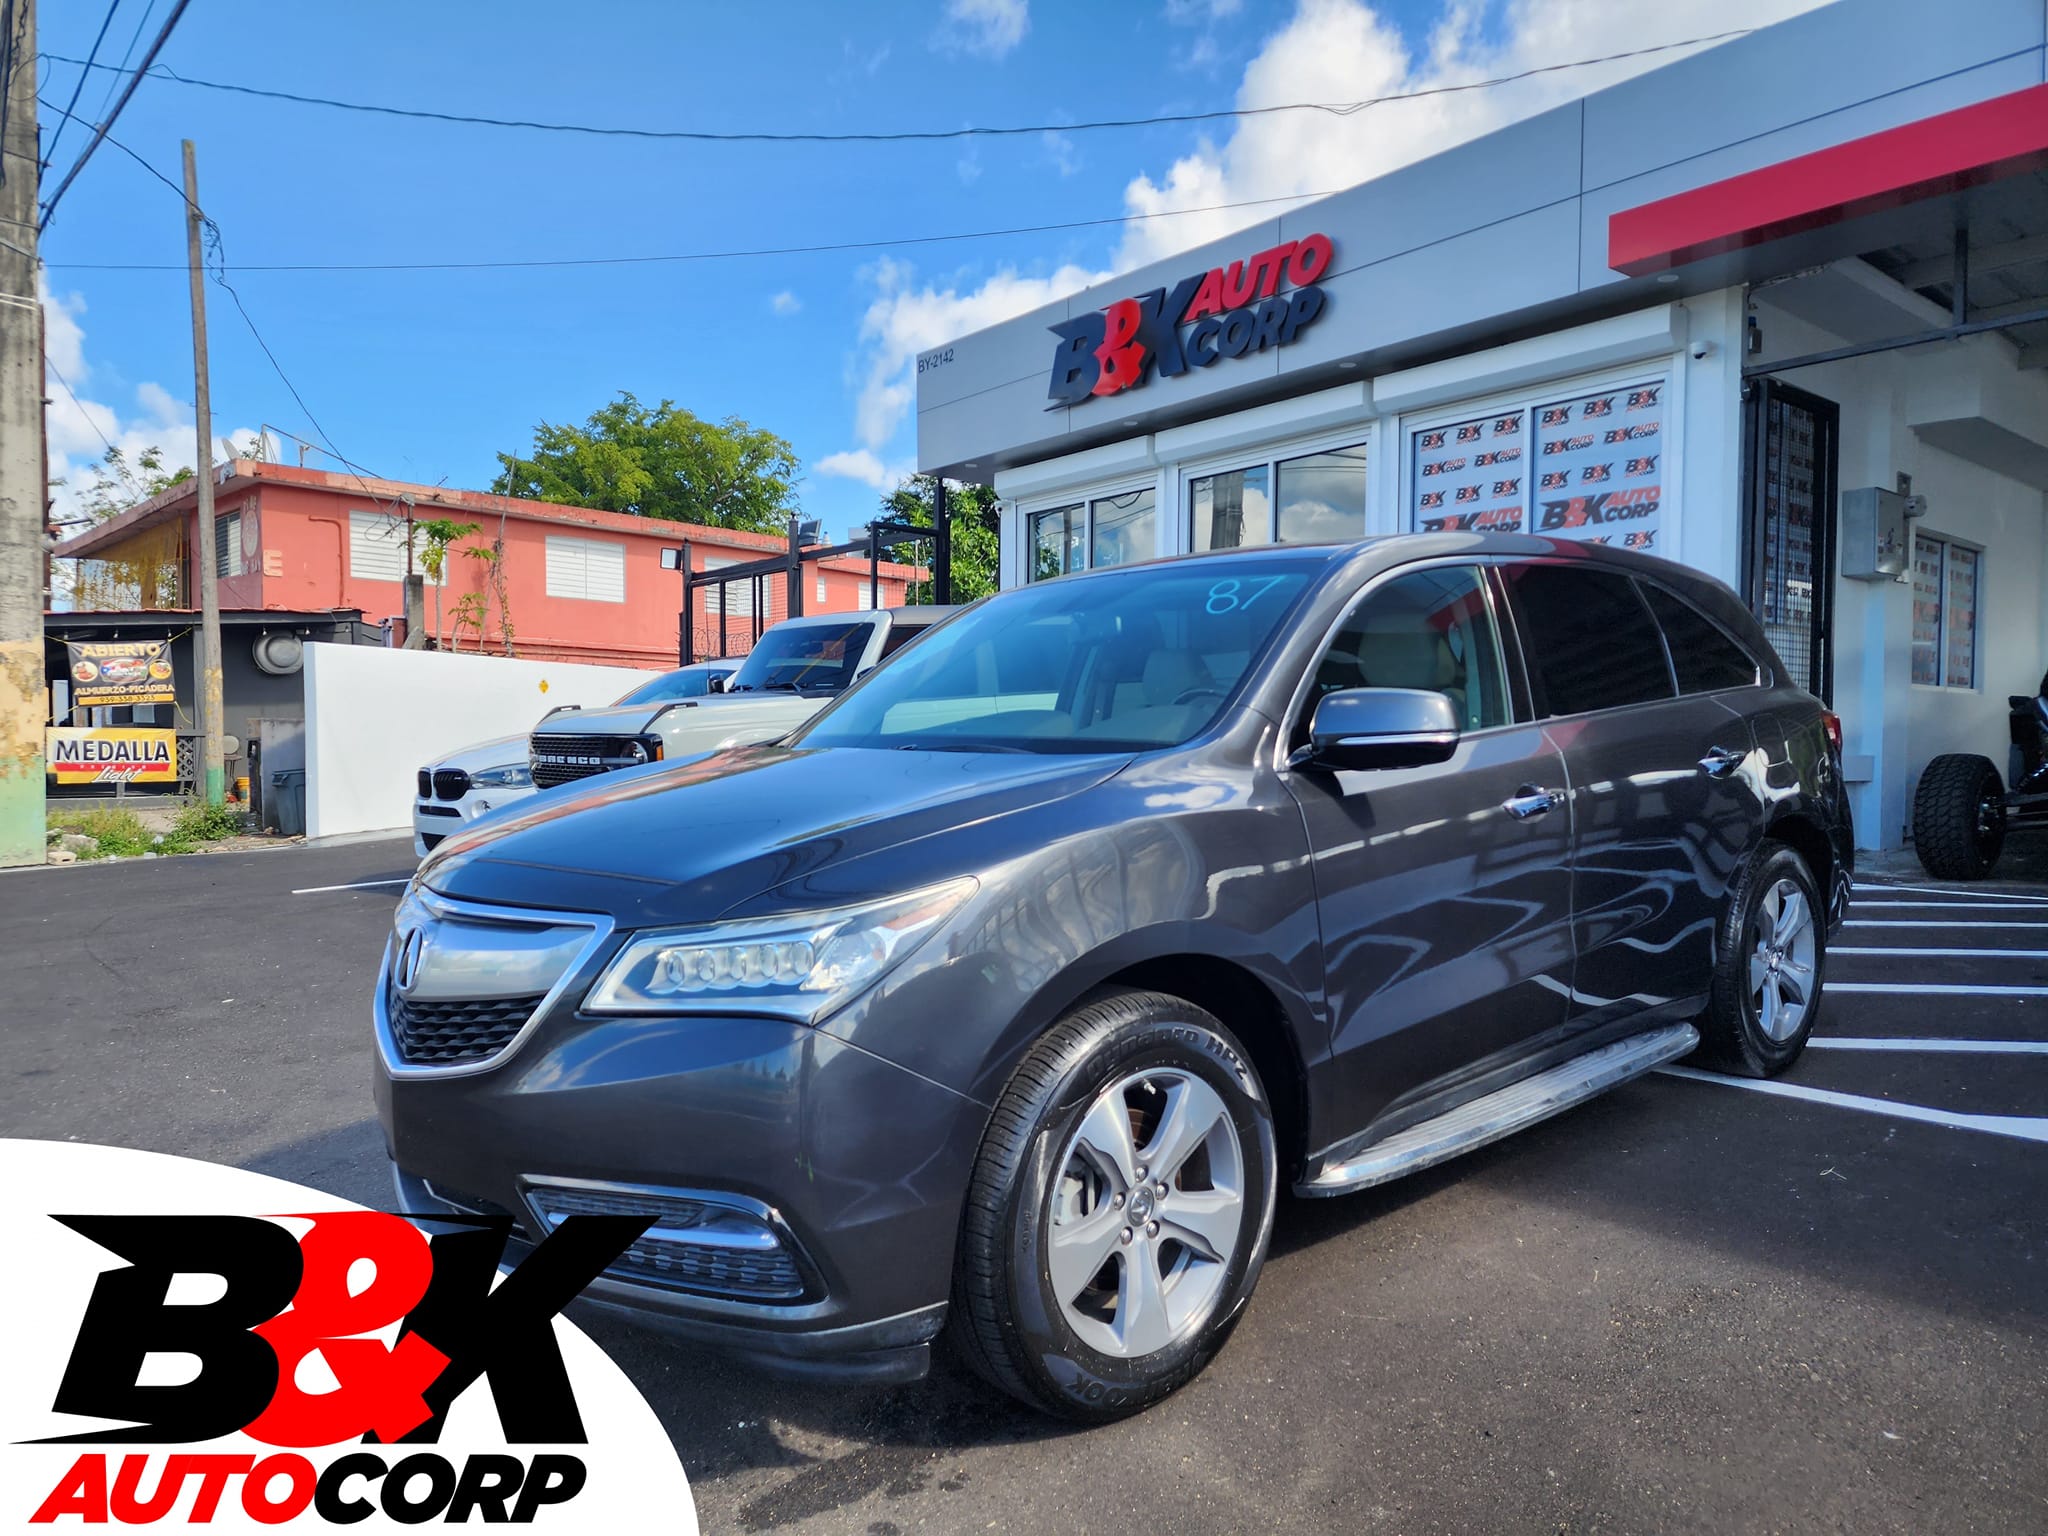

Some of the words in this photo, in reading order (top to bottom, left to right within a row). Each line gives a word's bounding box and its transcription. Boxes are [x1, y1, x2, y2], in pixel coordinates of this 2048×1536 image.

[1043, 273, 1208, 412] B&K
[1184, 233, 1334, 323] AUTO
[1186, 286, 1328, 367] CORP
[918, 348, 954, 374] BY-2142
[1627, 387, 1661, 406] B&K
[1542, 405, 1572, 423] B&K
[1583, 397, 1616, 415] B&K
[1456, 423, 1484, 440] B&K
[1493, 415, 1523, 432] B&K
[1421, 431, 1448, 447] B&K
[1603, 426, 1636, 444] B&K
[1633, 422, 1660, 432] AUTO
[1633, 429, 1658, 438] CORP
[1543, 438, 1573, 455] B&K
[1570, 433, 1594, 443] AUTO
[1571, 441, 1594, 450] CORP
[1474, 451, 1501, 467] B&K
[1500, 447, 1521, 457] AUTO
[1625, 455, 1659, 473] B&K
[1422, 461, 1447, 476] B&K
[1541, 469, 1571, 486] B&K
[1582, 463, 1614, 479] B&K
[1456, 484, 1483, 500] B&K
[1493, 478, 1521, 494] B&K
[1421, 490, 1446, 505] B&K
[1474, 506, 1523, 525] AUTO
[1536, 492, 1613, 532] B&K
[1604, 485, 1661, 508] AUTO
[1605, 501, 1659, 522] CORP
[1624, 529, 1658, 547] B&K
[1206, 574, 1288, 614] 87
[81, 643, 161, 657] ABIERTO
[55, 739, 171, 762] MEDALLA
[91, 765, 144, 783] Light
